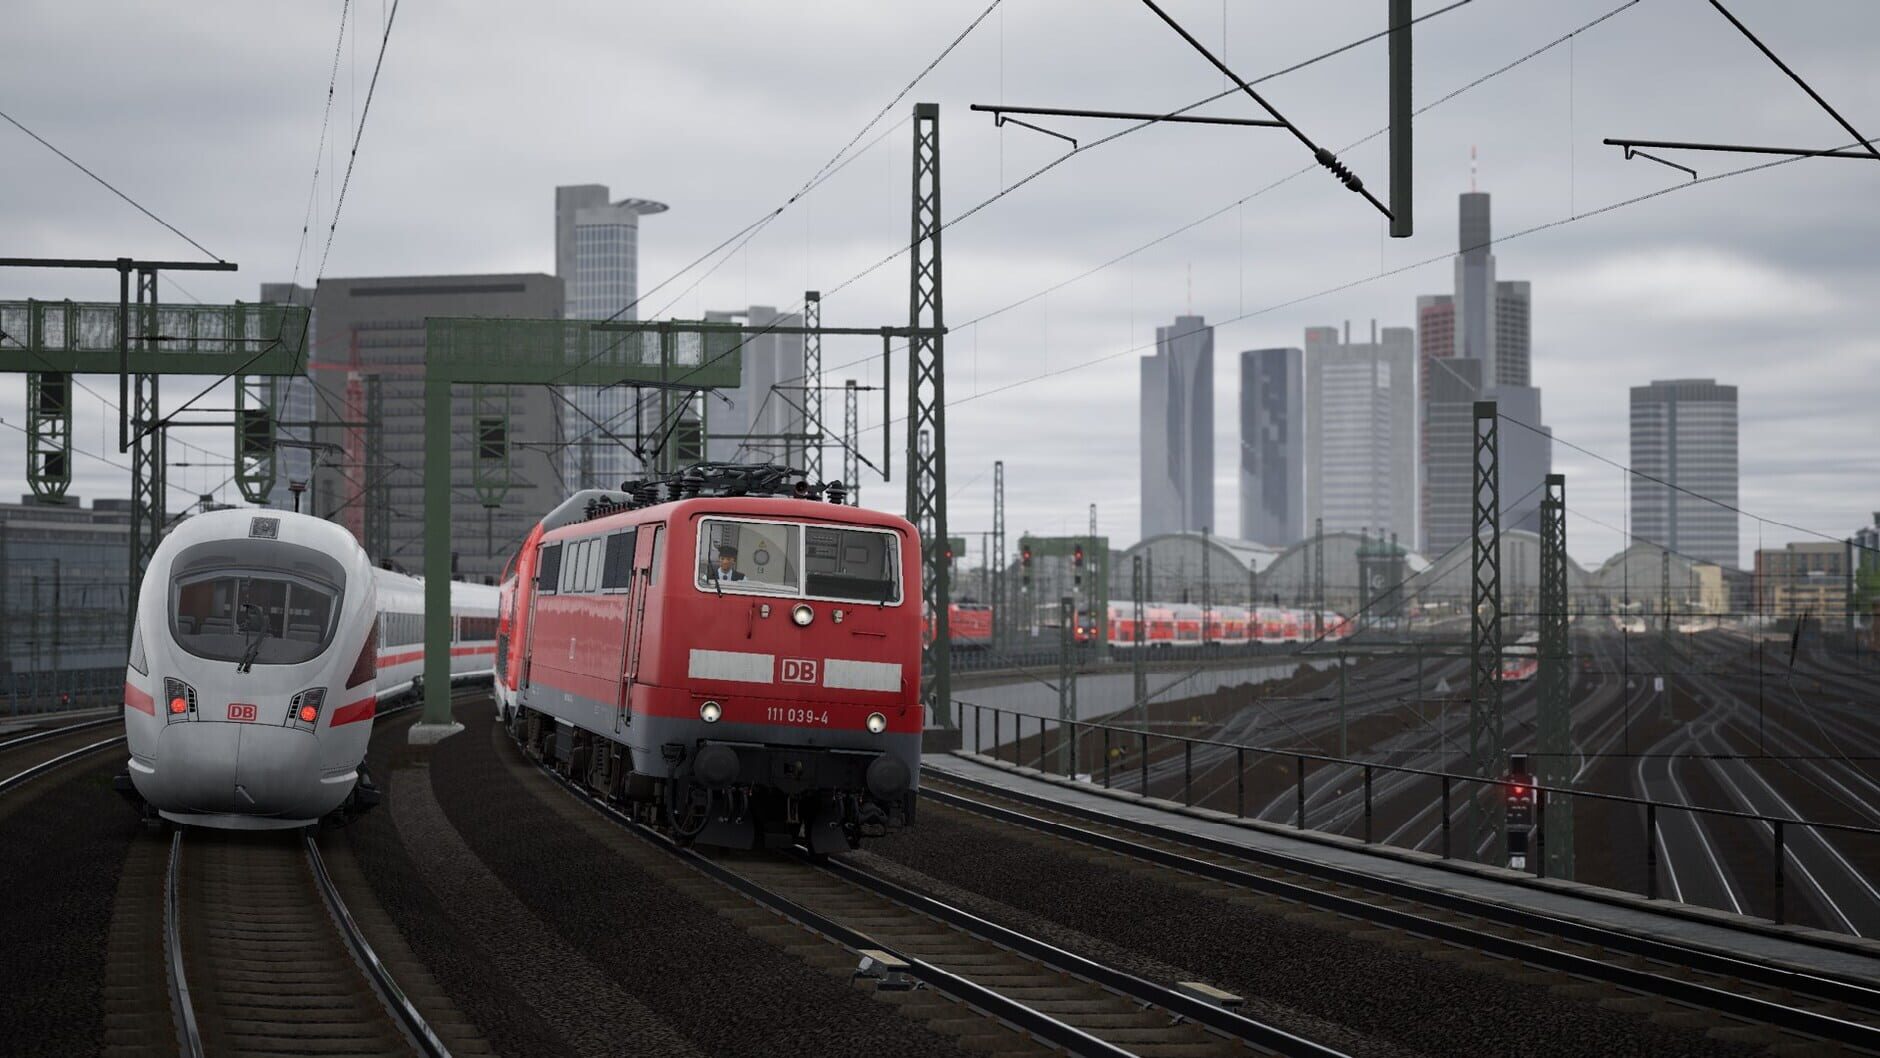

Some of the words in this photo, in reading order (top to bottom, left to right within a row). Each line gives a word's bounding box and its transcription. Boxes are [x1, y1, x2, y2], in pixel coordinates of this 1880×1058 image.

[783, 660, 815, 682] DB
[229, 705, 255, 719] DB
[767, 707, 783, 721] 111
[788, 708, 828, 724] 039-4
